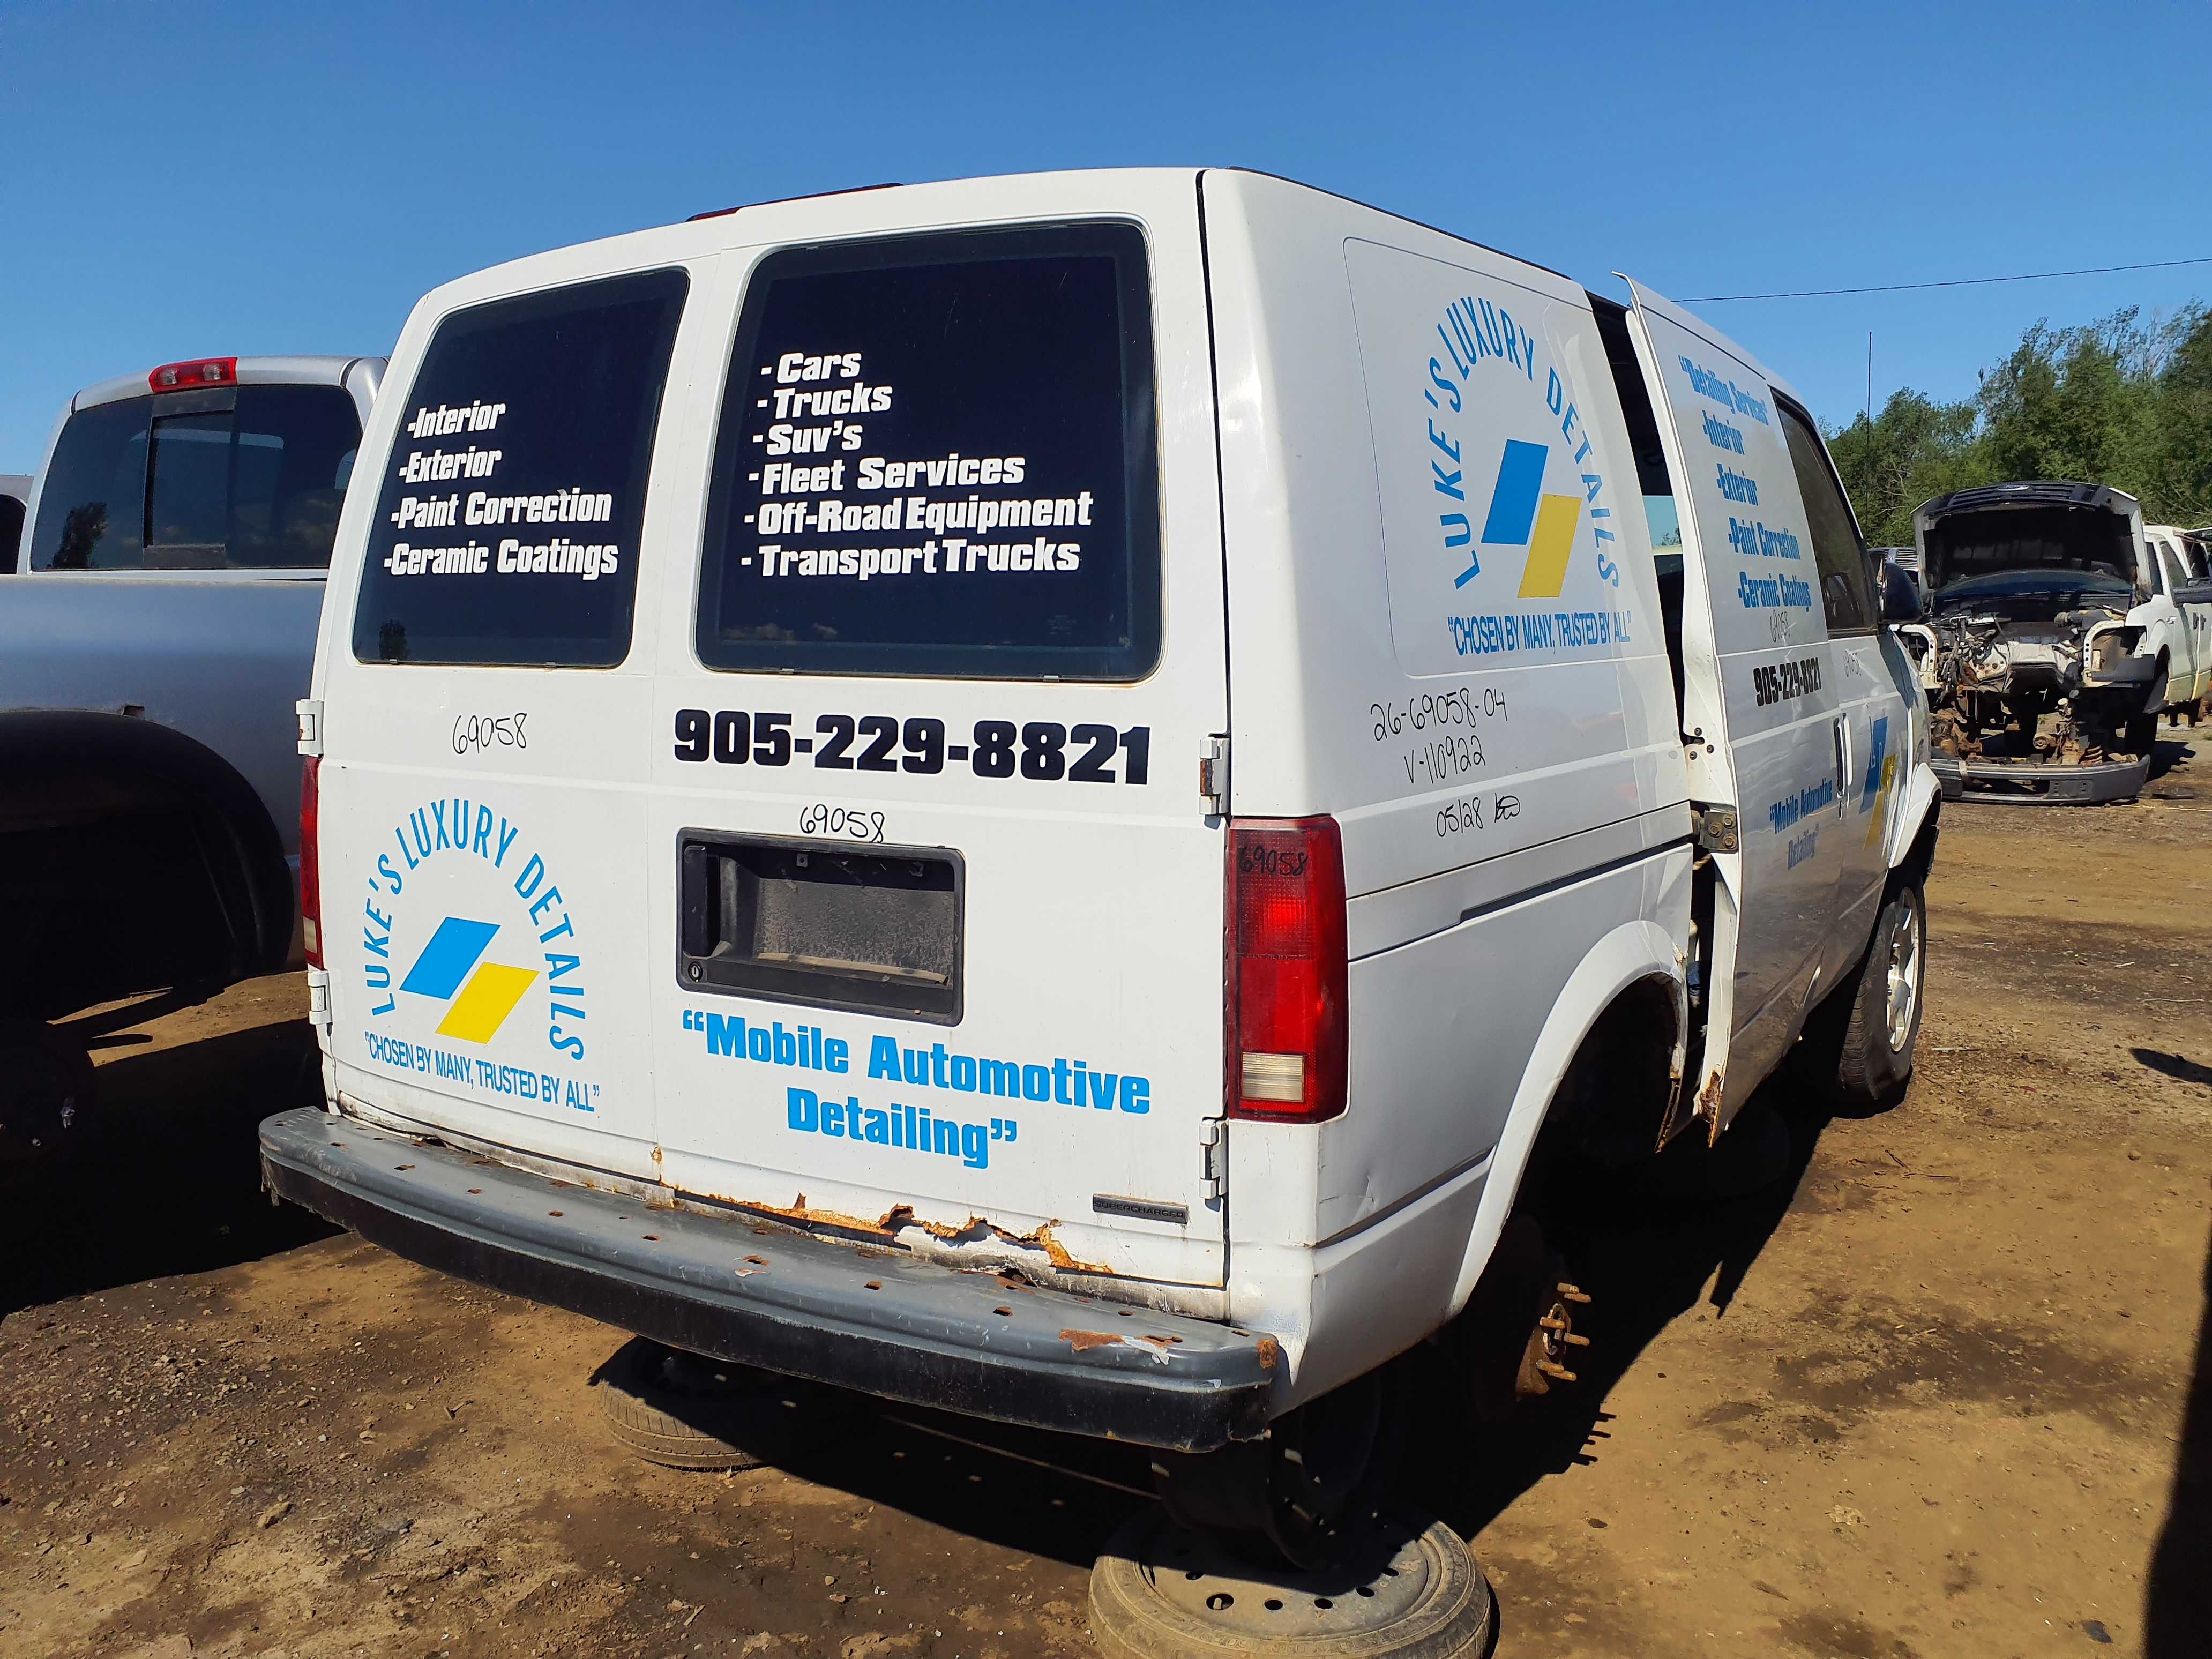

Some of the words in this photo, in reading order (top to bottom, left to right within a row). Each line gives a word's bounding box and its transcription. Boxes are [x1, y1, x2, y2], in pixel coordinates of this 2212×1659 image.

[1437, 296, 1533, 381] LUXURY
[857, 453, 1026, 490] Services
[1425, 357, 1480, 589] LUKE'S
[1546, 367, 1619, 587] DETAILS
[465, 488, 612, 525] Correction
[906, 491, 1093, 535] Equipment
[497, 538, 618, 580] Coatings
[942, 537, 1080, 572] Trucks
[1757, 522, 1801, 560] Correction
[1779, 573, 1812, 612] Coatings
[1505, 616, 1520, 651] BY
[1521, 614, 1556, 654] MANY,
[1555, 612, 1598, 647] TRUSTED
[1598, 612, 1611, 644] BY
[1753, 657, 1822, 707] 905-229-8821
[453, 713, 527, 754] 69058
[1370, 687, 1508, 741] 26-69058-04
[674, 709, 1152, 786] 905-229-8821
[1404, 735, 1486, 784] V-110922
[1800, 777, 1832, 819] Automotive
[800, 804, 885, 843] 69058
[1237, 845, 1309, 876] 69058
[364, 853, 402, 1016] LUKE'S
[395, 798, 519, 871] LUXURY
[514, 853, 586, 1060] DETAILS
[417, 1046, 432, 1073] BY
[435, 1050, 474, 1090] MANY,
[475, 1060, 537, 1100] TRUSTED
[541, 1074, 561, 1104] BY
[867, 1035, 1152, 1116] Automotive
